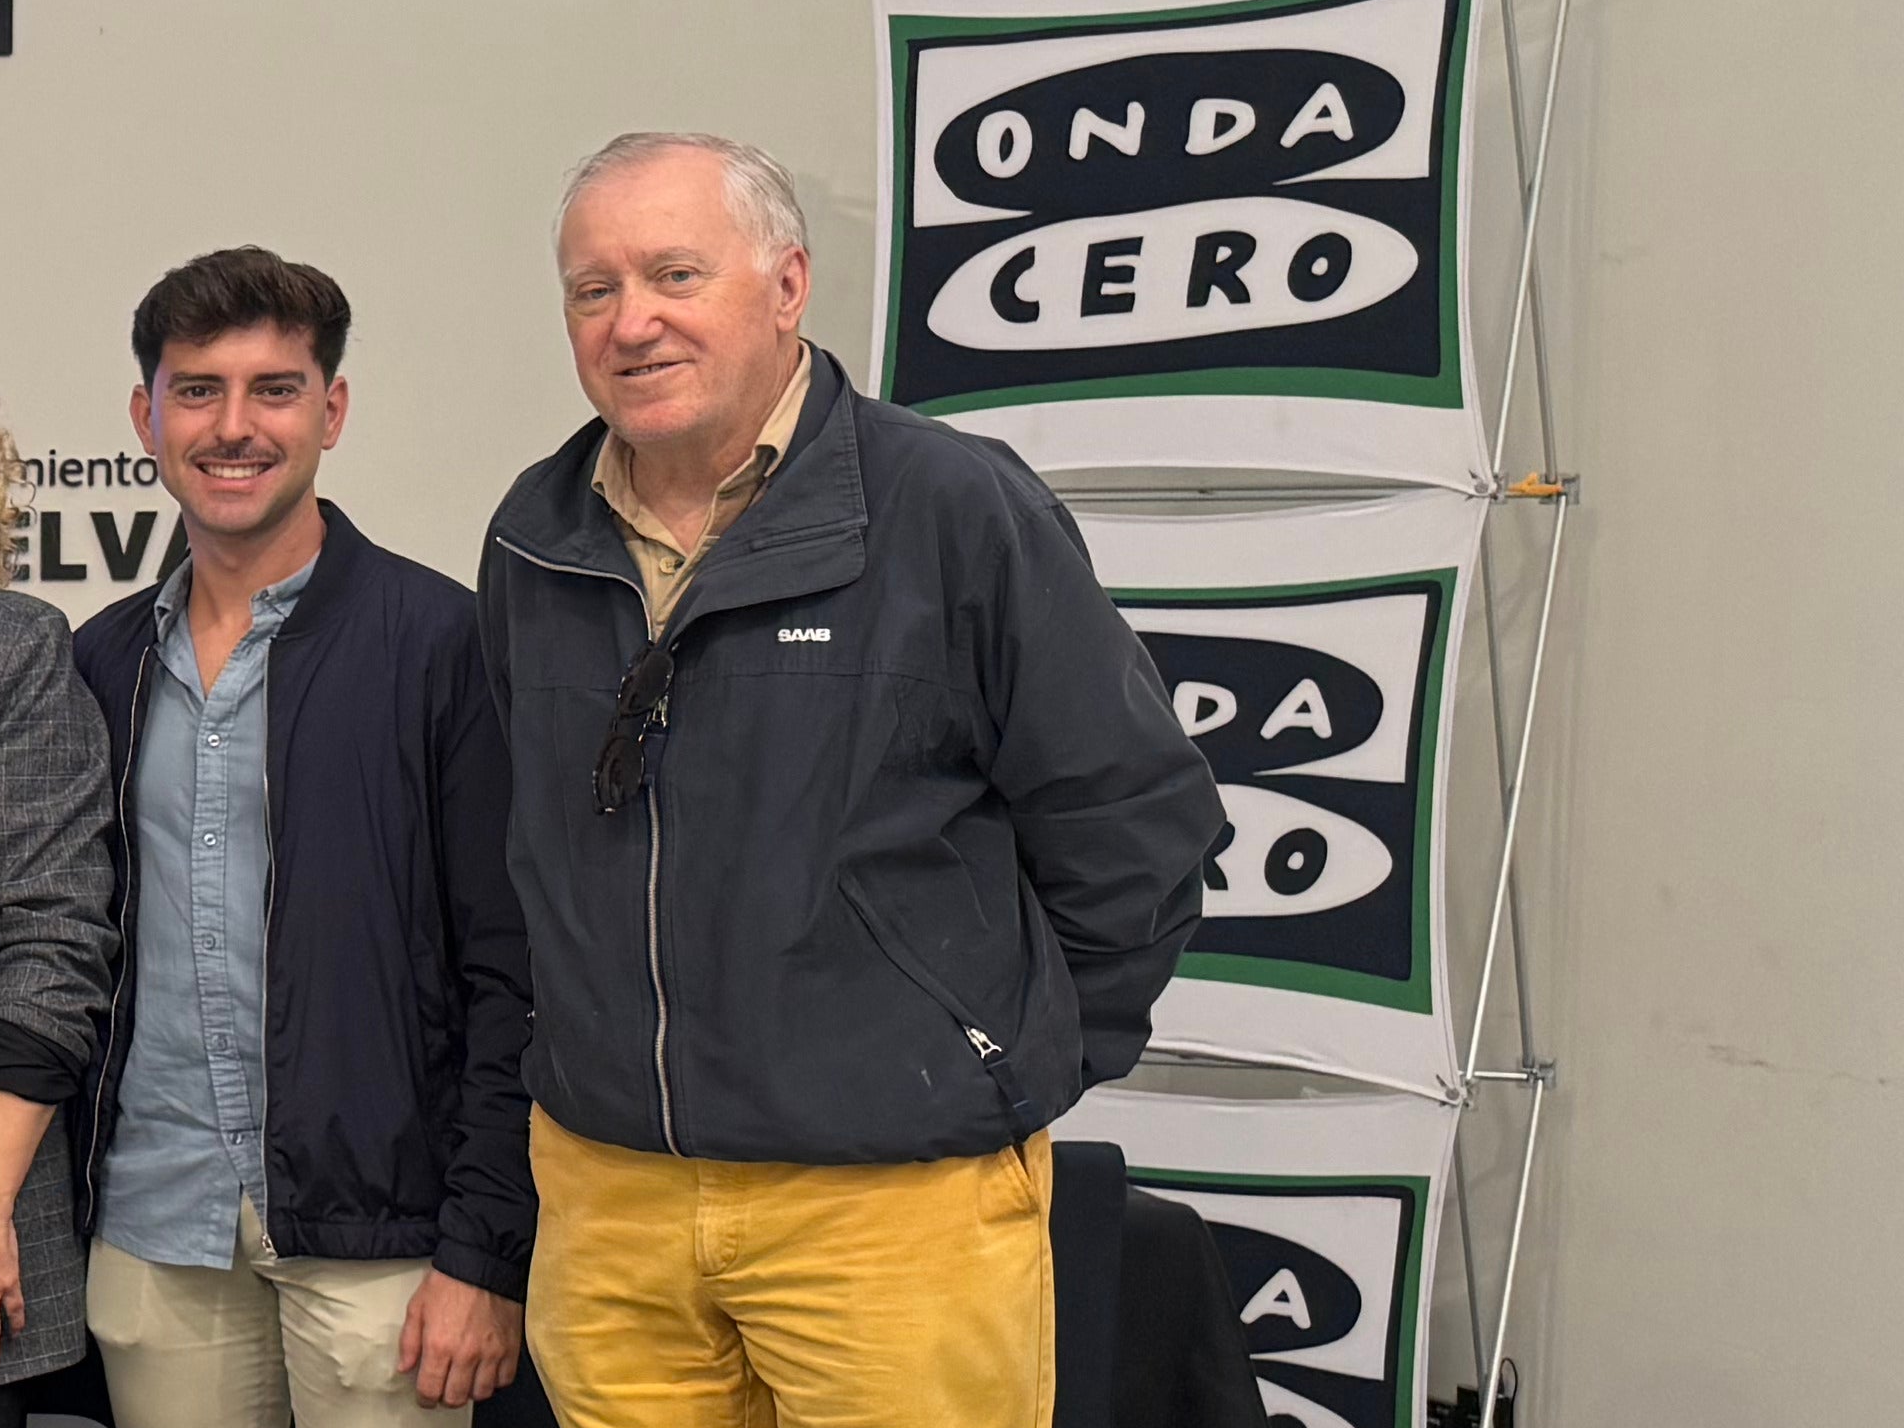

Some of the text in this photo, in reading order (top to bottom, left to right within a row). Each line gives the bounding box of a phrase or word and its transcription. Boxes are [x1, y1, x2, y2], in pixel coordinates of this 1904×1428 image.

[976, 82, 1354, 179] ONDA
[989, 230, 1352, 323] CERO
[777, 628, 832, 642] SAAB
[1173, 678, 1332, 740] DA
